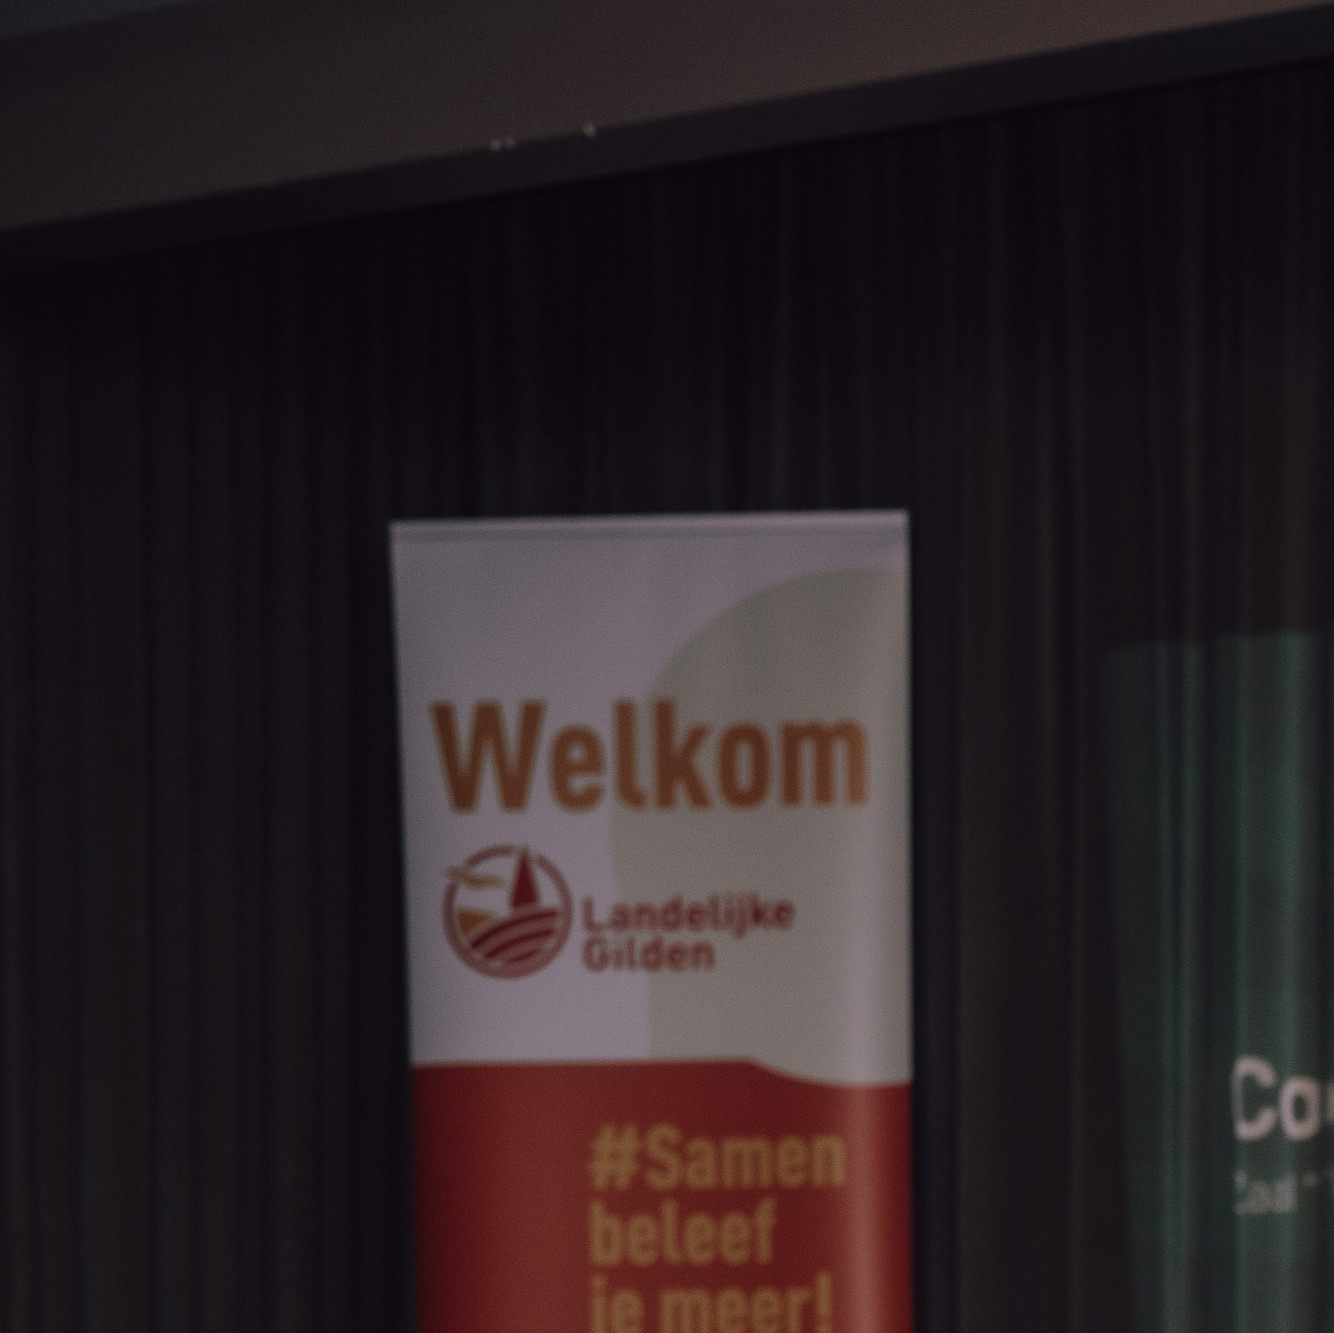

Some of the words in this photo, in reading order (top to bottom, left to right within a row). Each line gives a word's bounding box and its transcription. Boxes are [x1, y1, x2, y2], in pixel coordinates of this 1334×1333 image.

[431, 697, 870, 813] Welkom
[583, 892, 796, 940] Landelijke
[583, 936, 717, 973] Gilden
[591, 1122, 847, 1190] #Samen
[588, 1196, 778, 1266] beleef
